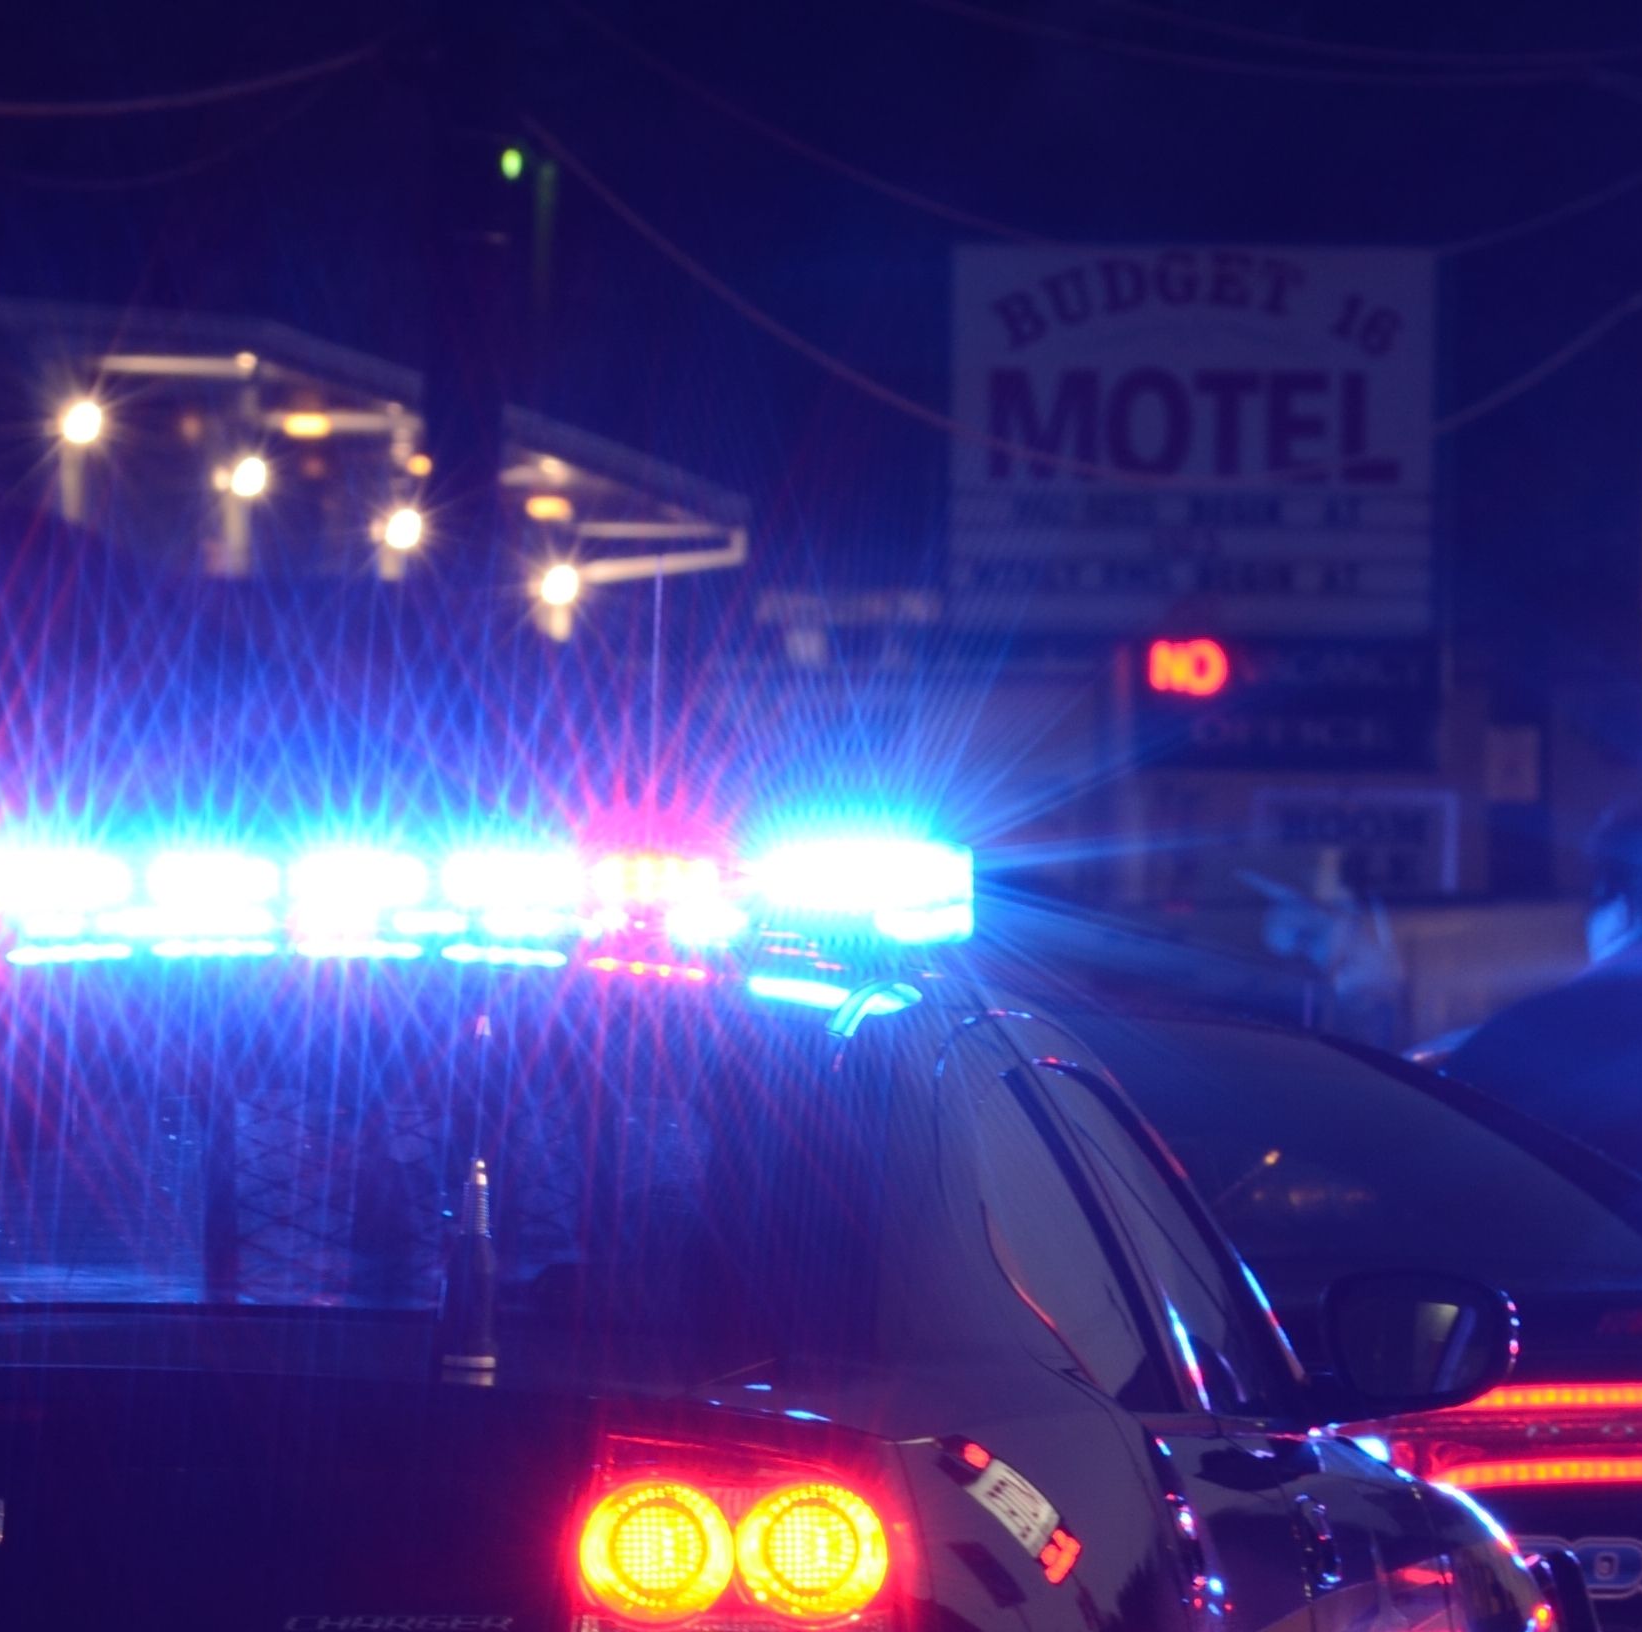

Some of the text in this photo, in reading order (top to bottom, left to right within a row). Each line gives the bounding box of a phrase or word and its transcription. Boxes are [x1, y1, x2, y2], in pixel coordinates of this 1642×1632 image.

[987, 249, 1405, 356] BUDGET 16
[985, 366, 1402, 482] MOTEL
[1148, 639, 1228, 697] NO
[283, 1614, 514, 1632] CHARGER
